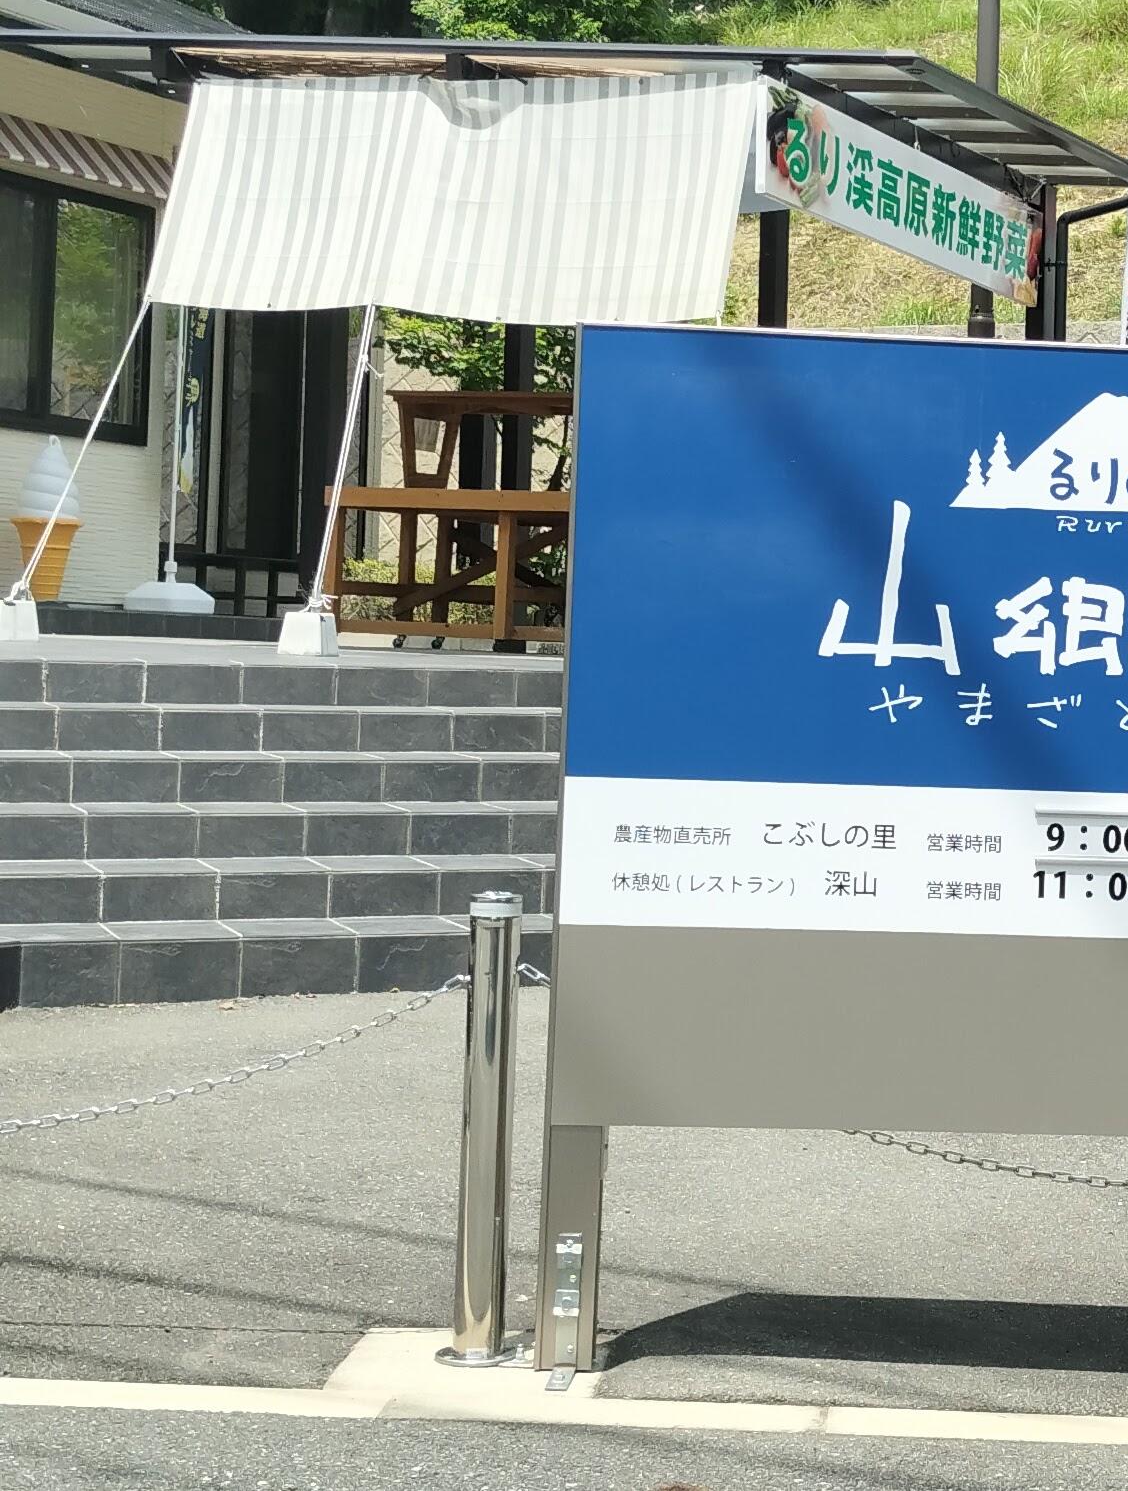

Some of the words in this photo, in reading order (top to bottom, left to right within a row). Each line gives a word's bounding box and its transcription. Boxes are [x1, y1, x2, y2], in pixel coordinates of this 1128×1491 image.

[783, 118, 1028, 280] るり渓高原新鮮野菜
[613, 824, 732, 846] 農産物直売所
[762, 821, 898, 850] こぶしの里
[926, 832, 1003, 854] 営業時間
[824, 869, 878, 898] 深山
[926, 880, 1003, 902] 営業時間
